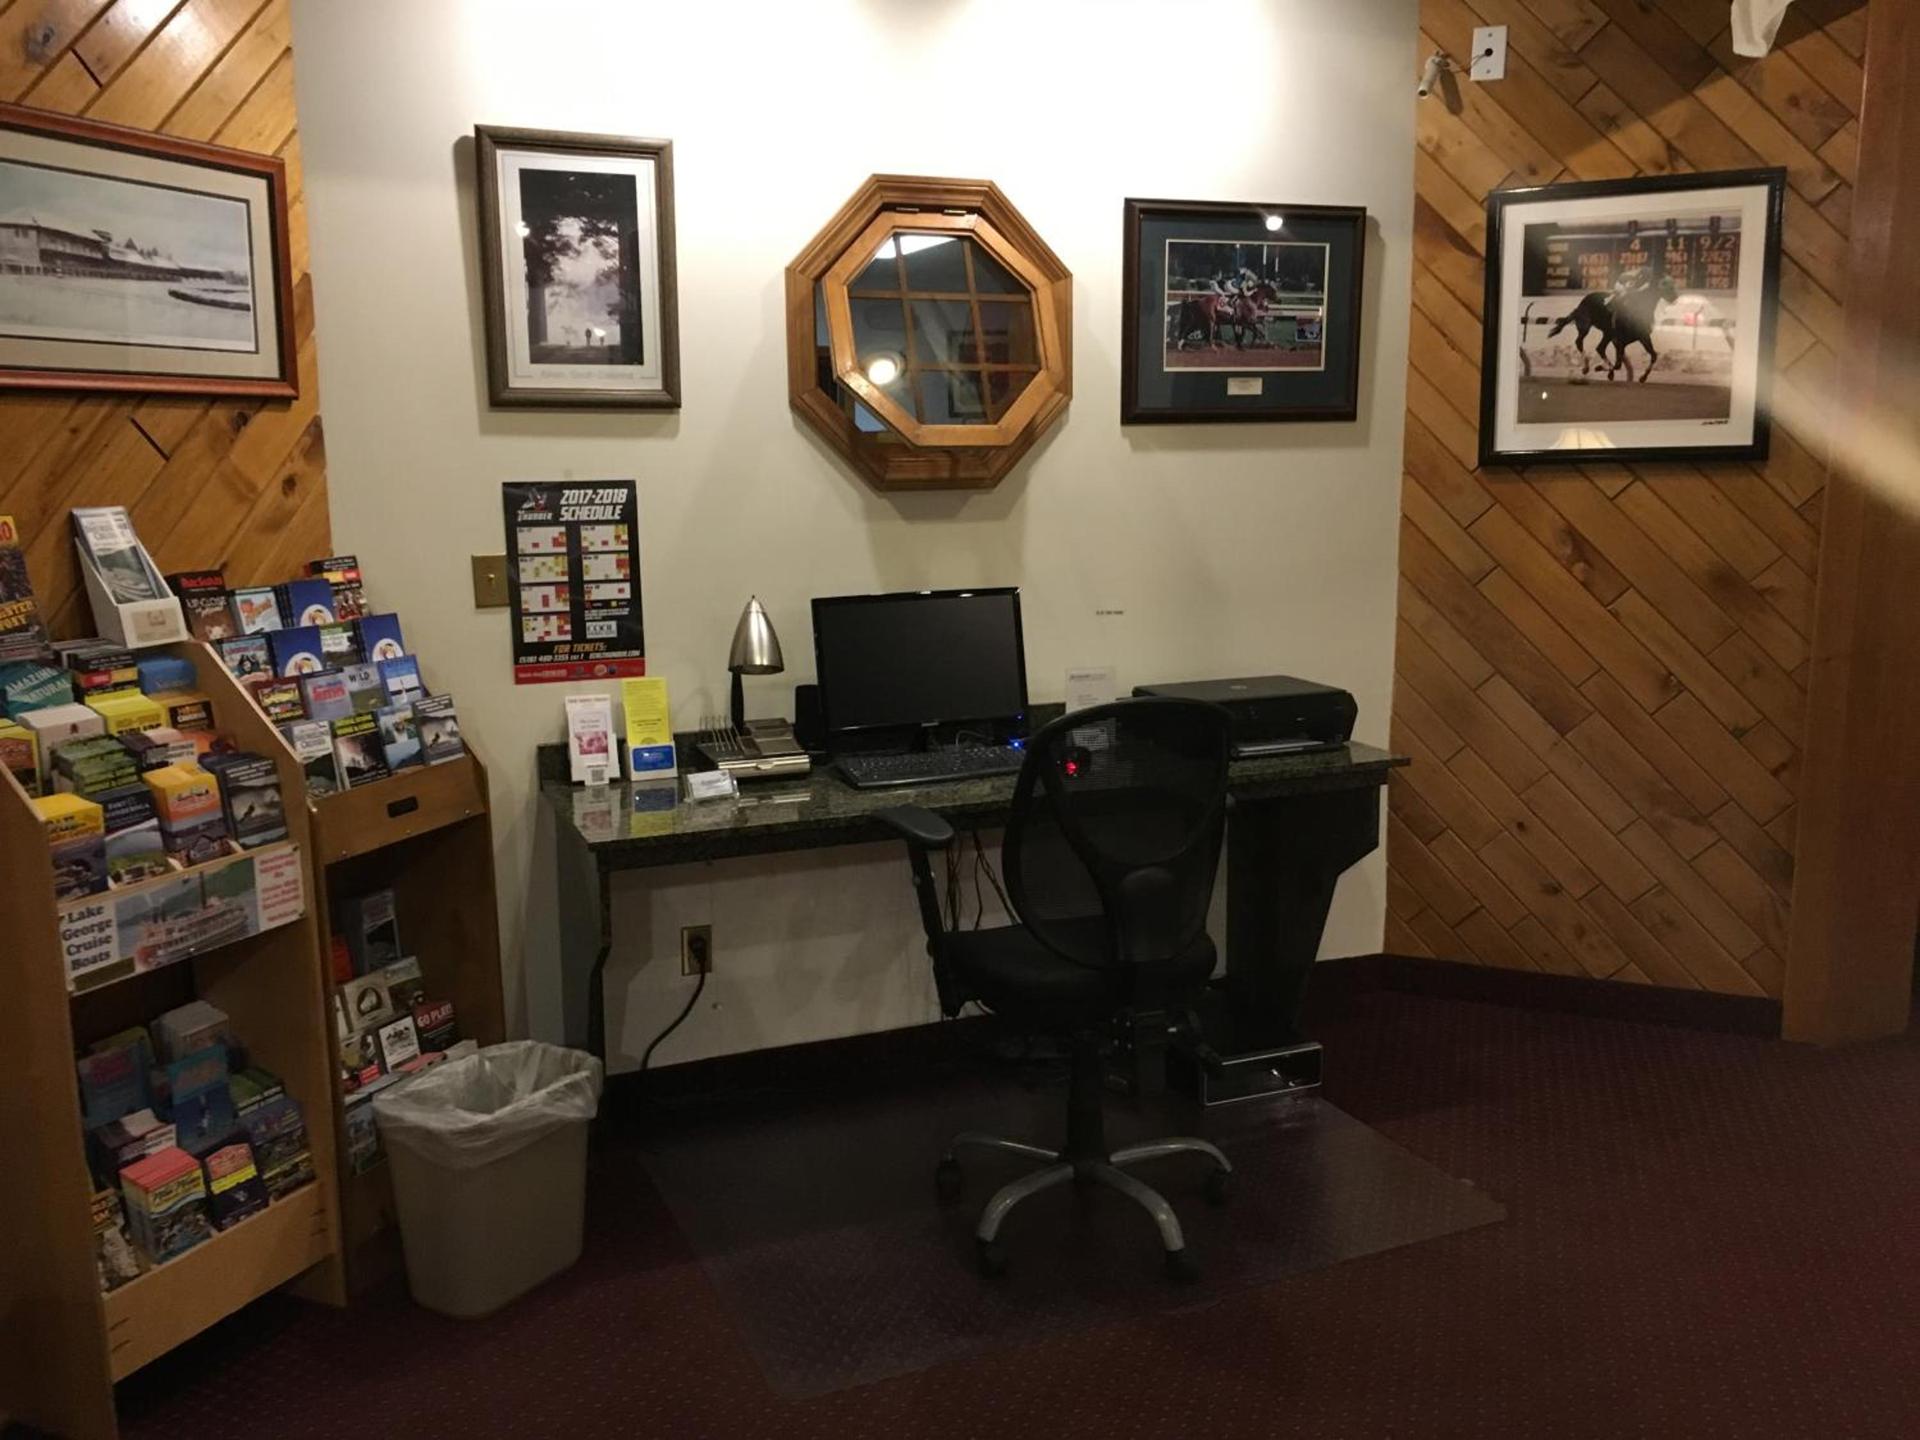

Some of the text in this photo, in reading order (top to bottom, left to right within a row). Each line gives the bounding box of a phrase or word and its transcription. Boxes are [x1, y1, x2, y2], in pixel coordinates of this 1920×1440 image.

[559, 505, 623, 521] SCHEDULE
[6, 667, 58, 694] AMAZING
[67, 906, 104, 923] Lake
[61, 919, 112, 941] George
[66, 935, 112, 956] Cruise
[71, 951, 111, 971] Boats
